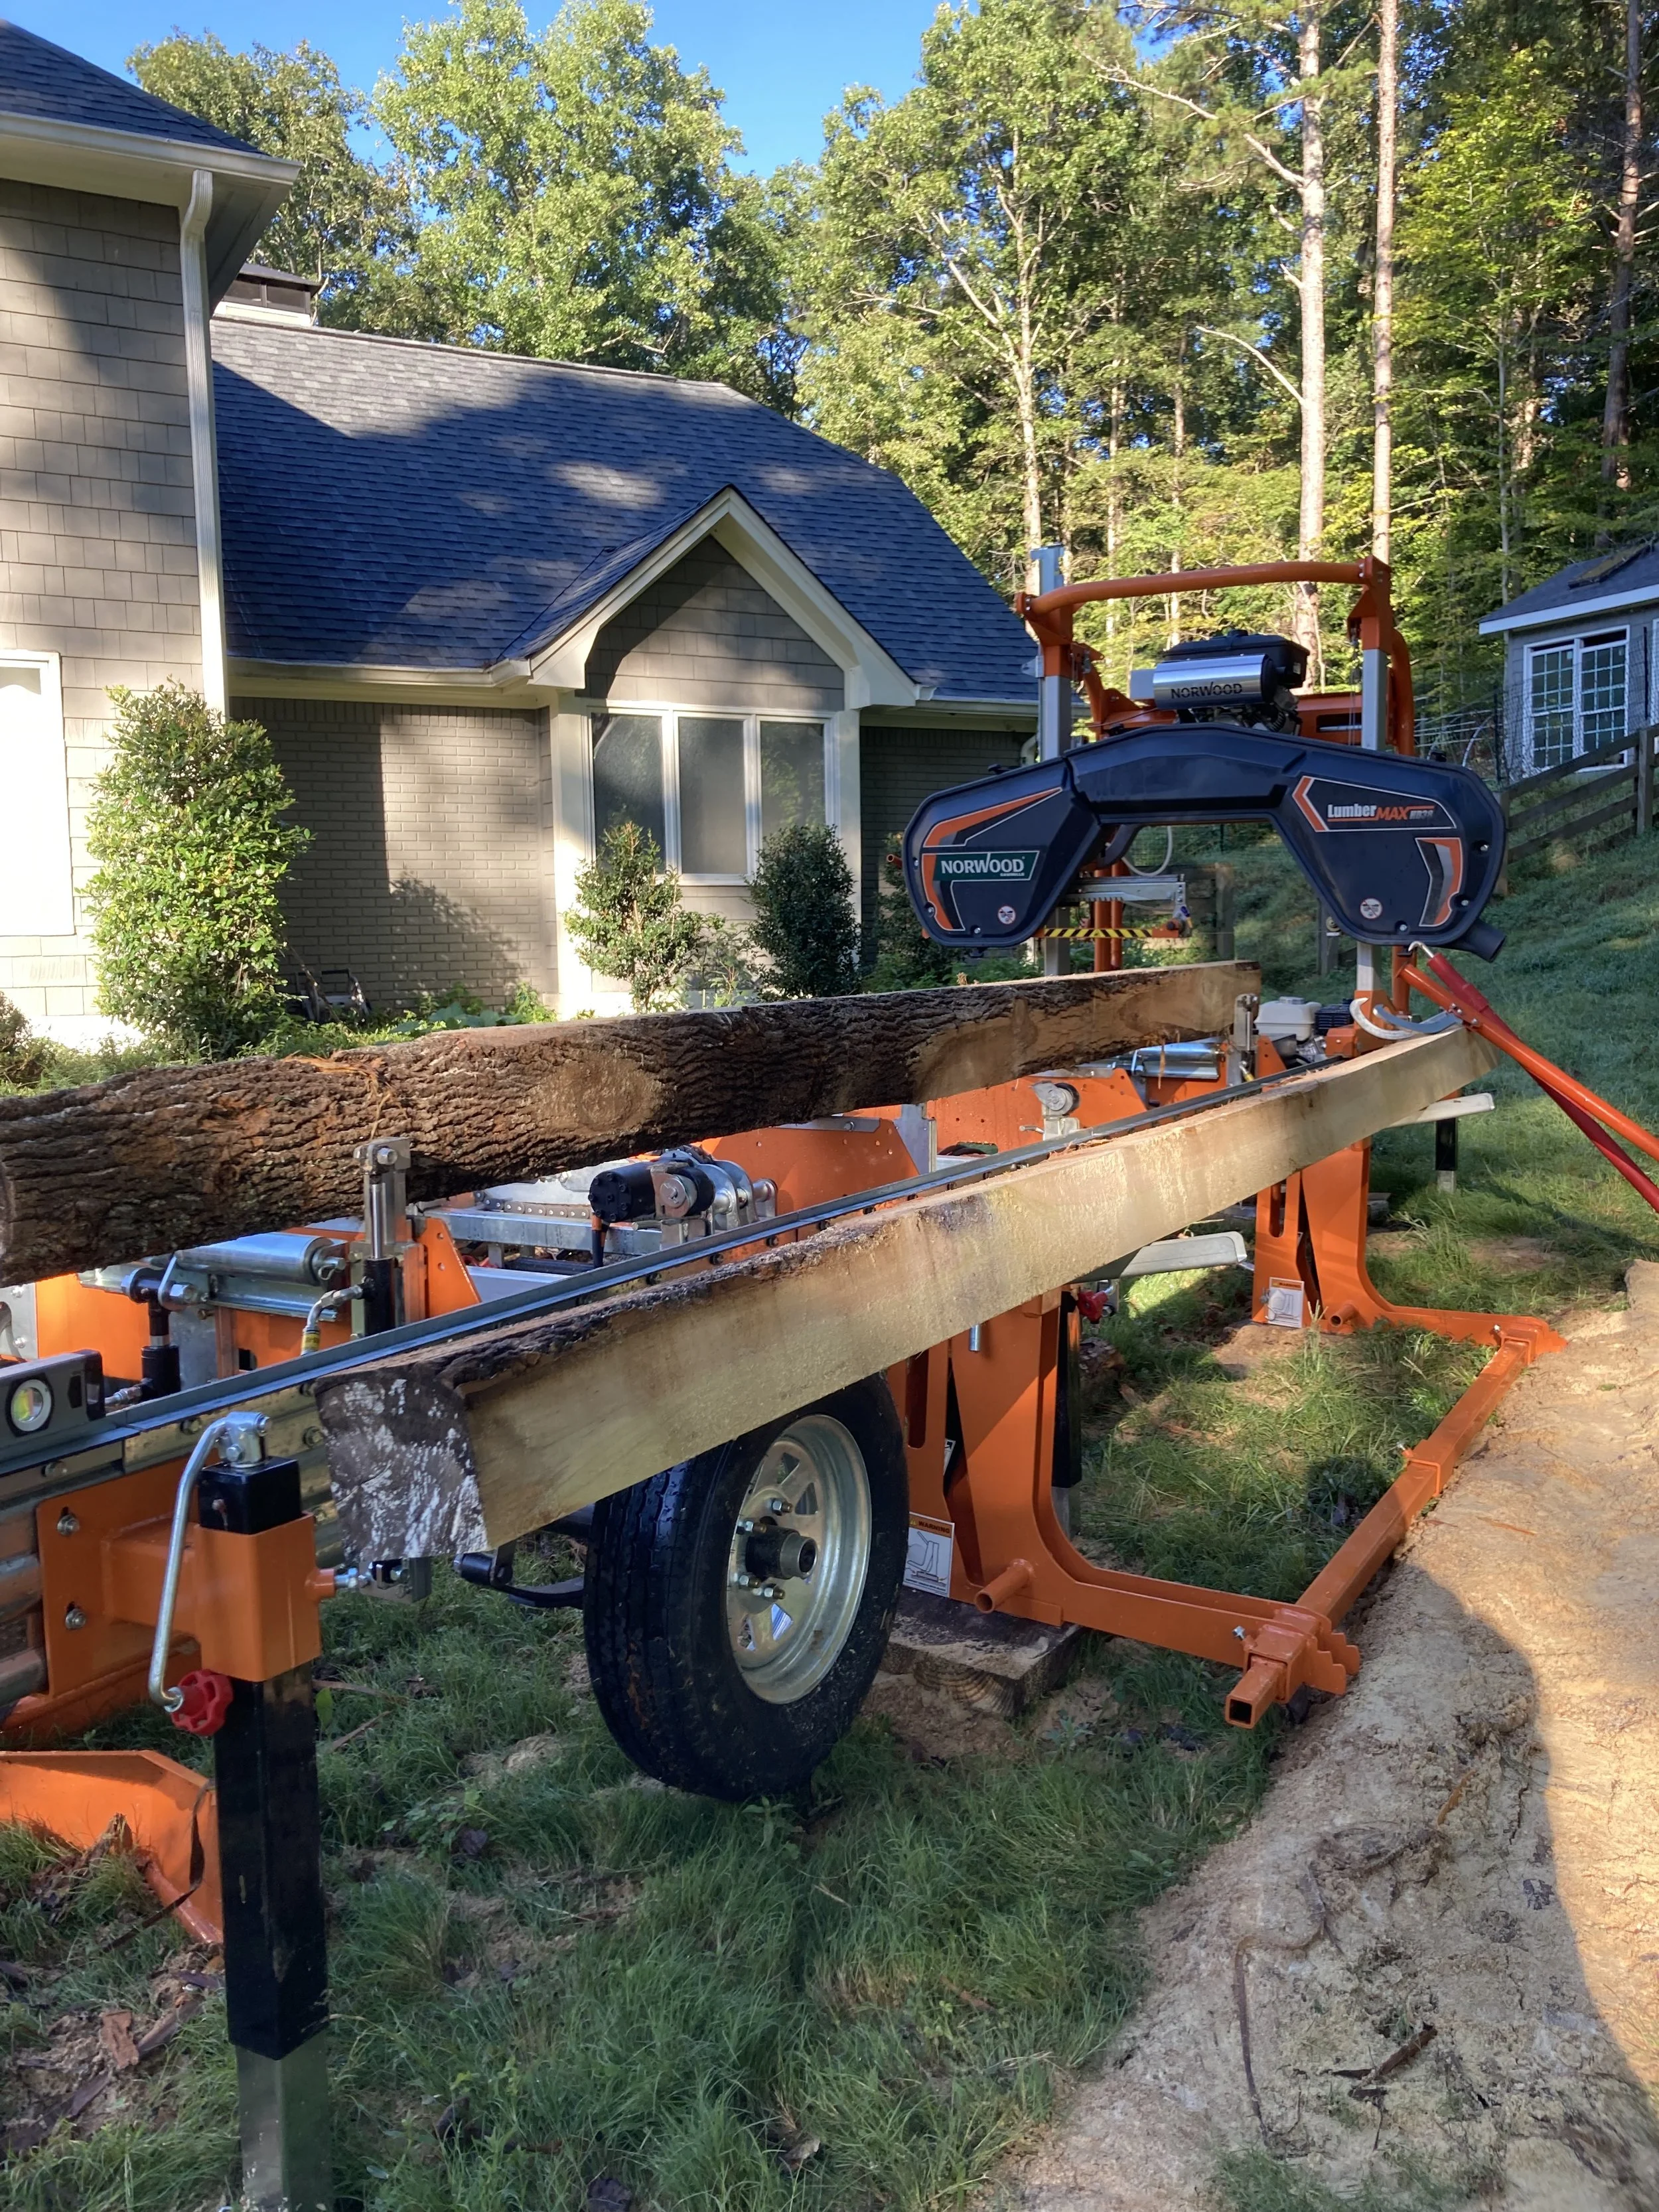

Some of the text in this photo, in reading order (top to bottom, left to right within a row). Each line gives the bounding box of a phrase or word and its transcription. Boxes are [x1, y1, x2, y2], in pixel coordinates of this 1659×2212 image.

[1171, 682, 1242, 699] NORWOOD
[941, 853, 1025, 874] NORWOOD
[918, 1520, 950, 1534] WARNING
